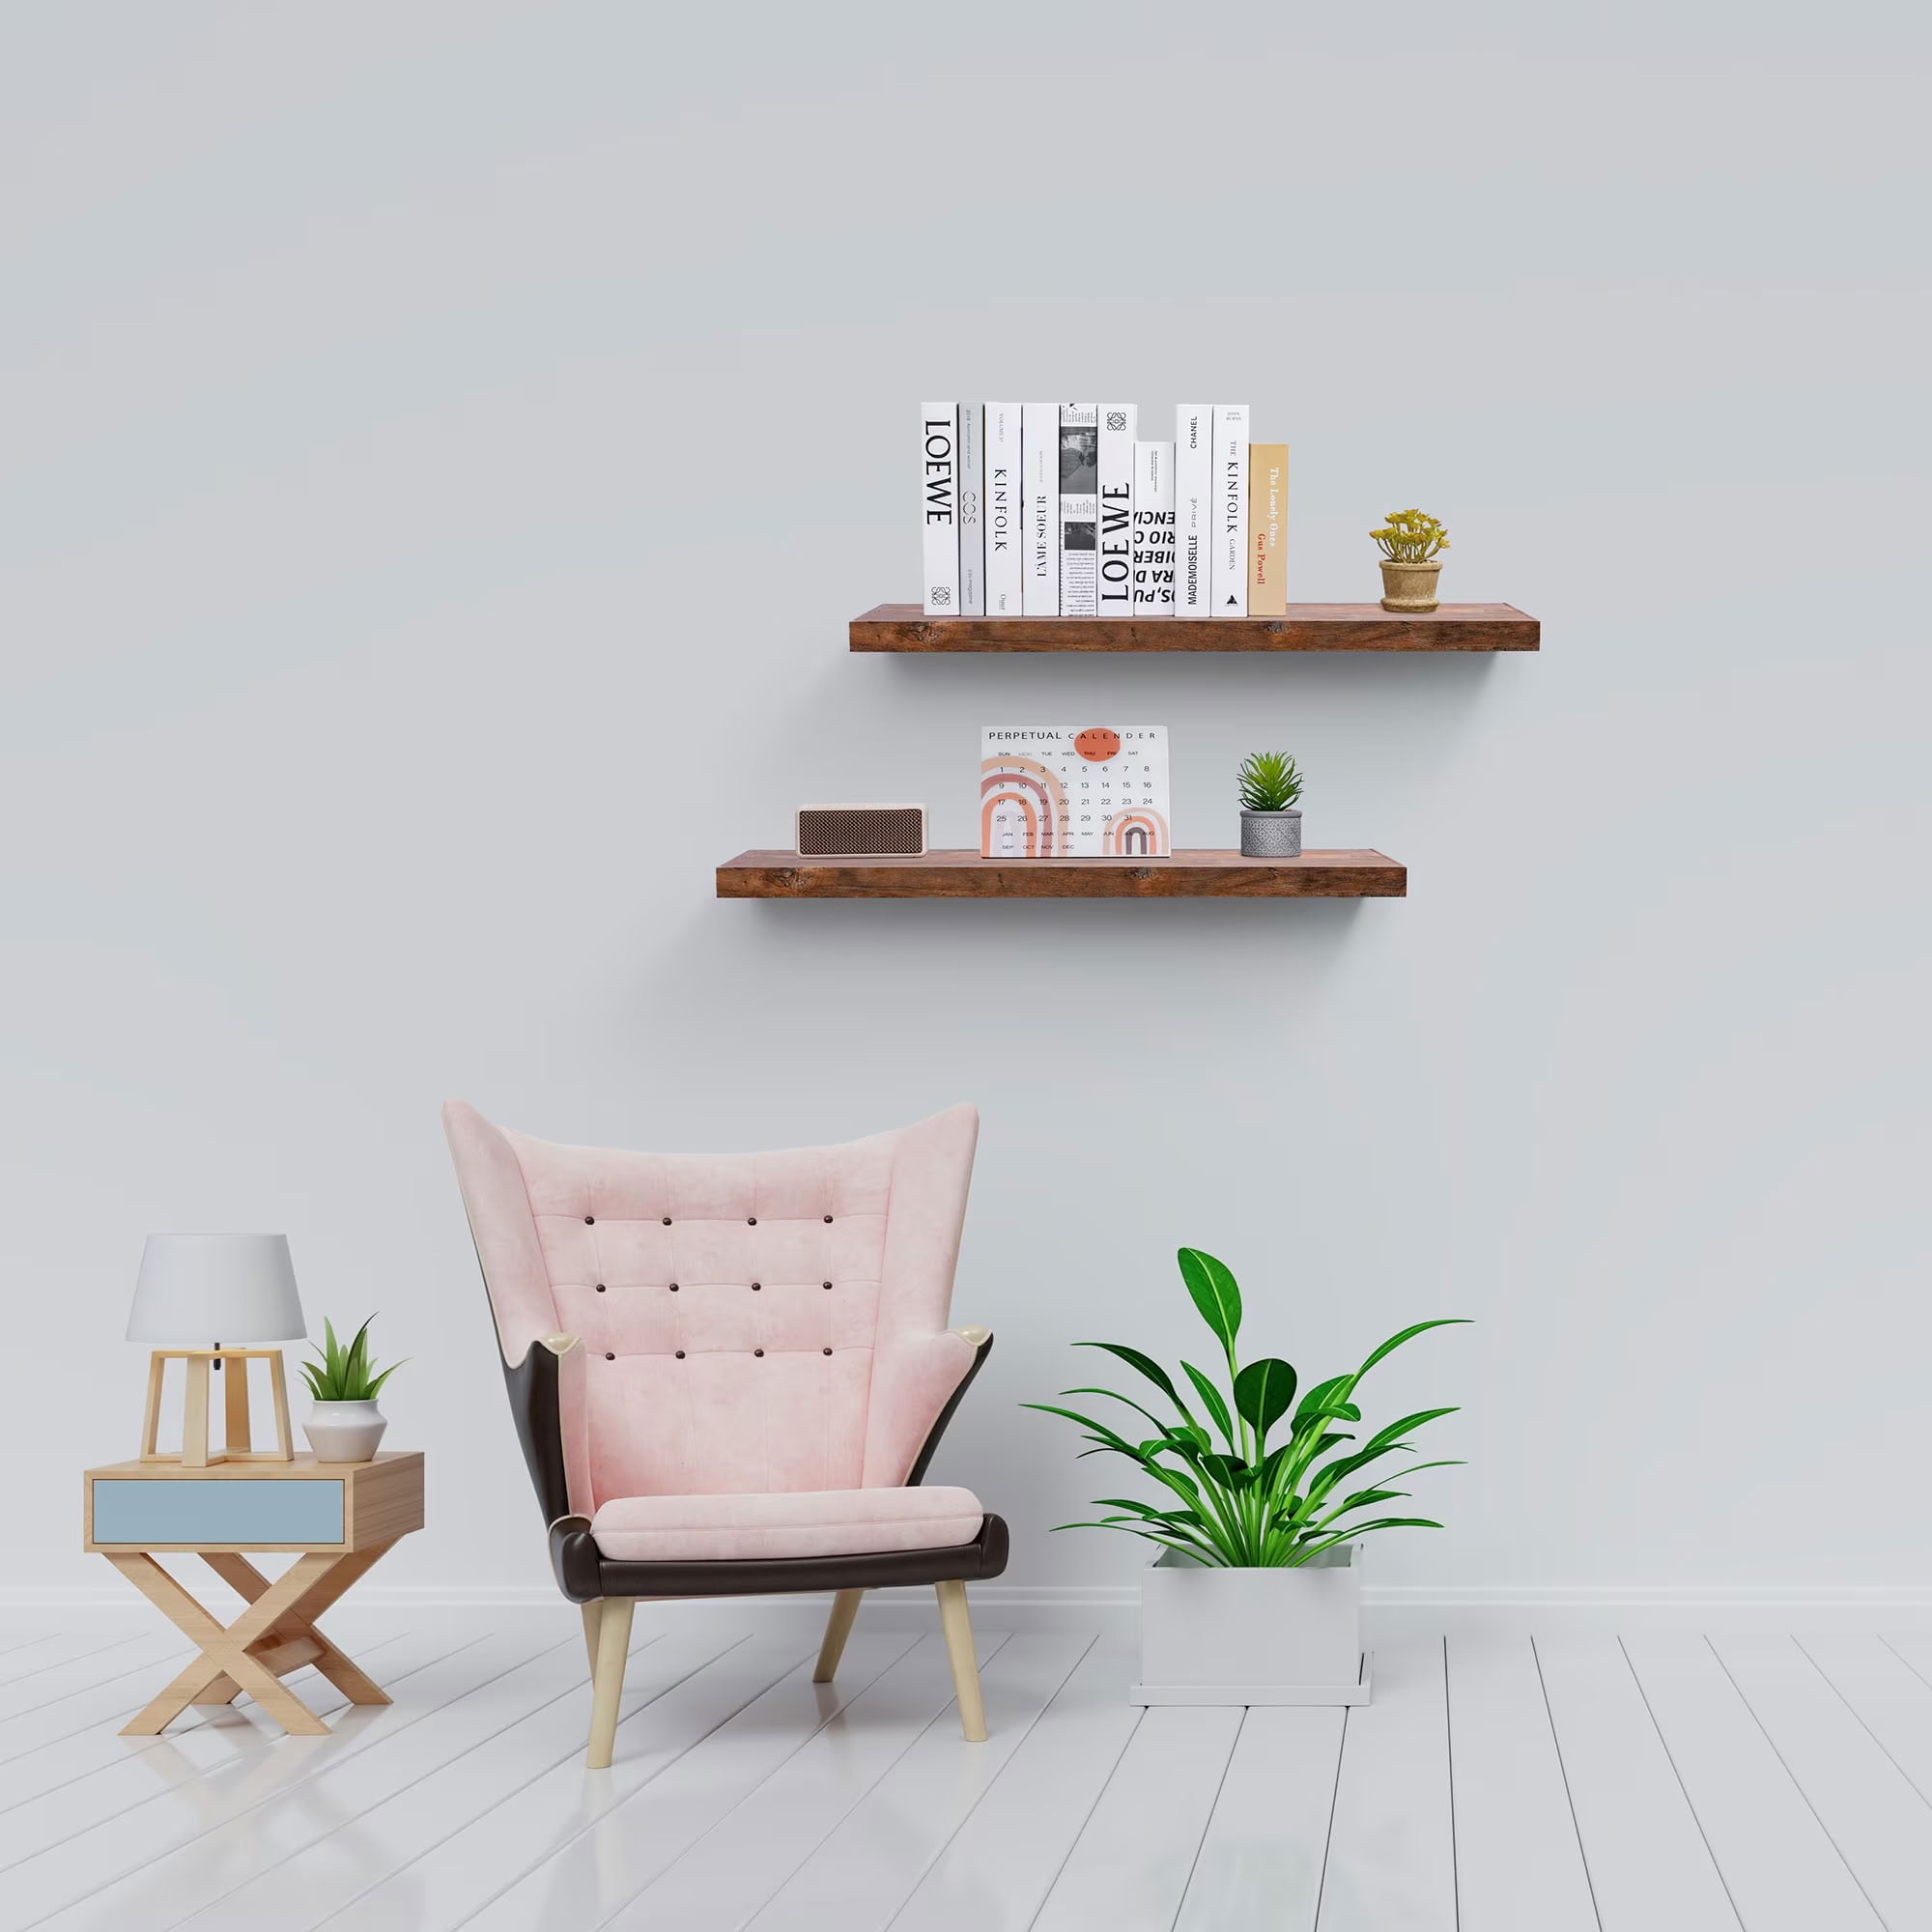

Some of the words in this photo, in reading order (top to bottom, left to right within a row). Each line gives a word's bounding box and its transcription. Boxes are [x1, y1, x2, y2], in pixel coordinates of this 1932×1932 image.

[925, 420, 952, 525] LOEWE
[1269, 467, 1279, 485] The
[963, 491, 976, 525] COS
[994, 469, 1007, 552] KINFOLK
[1227, 462, 1238, 533] KINFOLK
[1267, 489, 1279, 520] Lonely
[1037, 496, 1046, 539] SOEUR
[1102, 483, 1129, 601] LOEWE
[1134, 531, 1145, 544] C
[1149, 531, 1175, 544] RIO
[1269, 523, 1279, 547] Ones
[1188, 535, 1197, 605] MADEMOISELLE
[1257, 554, 1265, 584] Powell
[988, 731, 1062, 740] PERPETUAL
